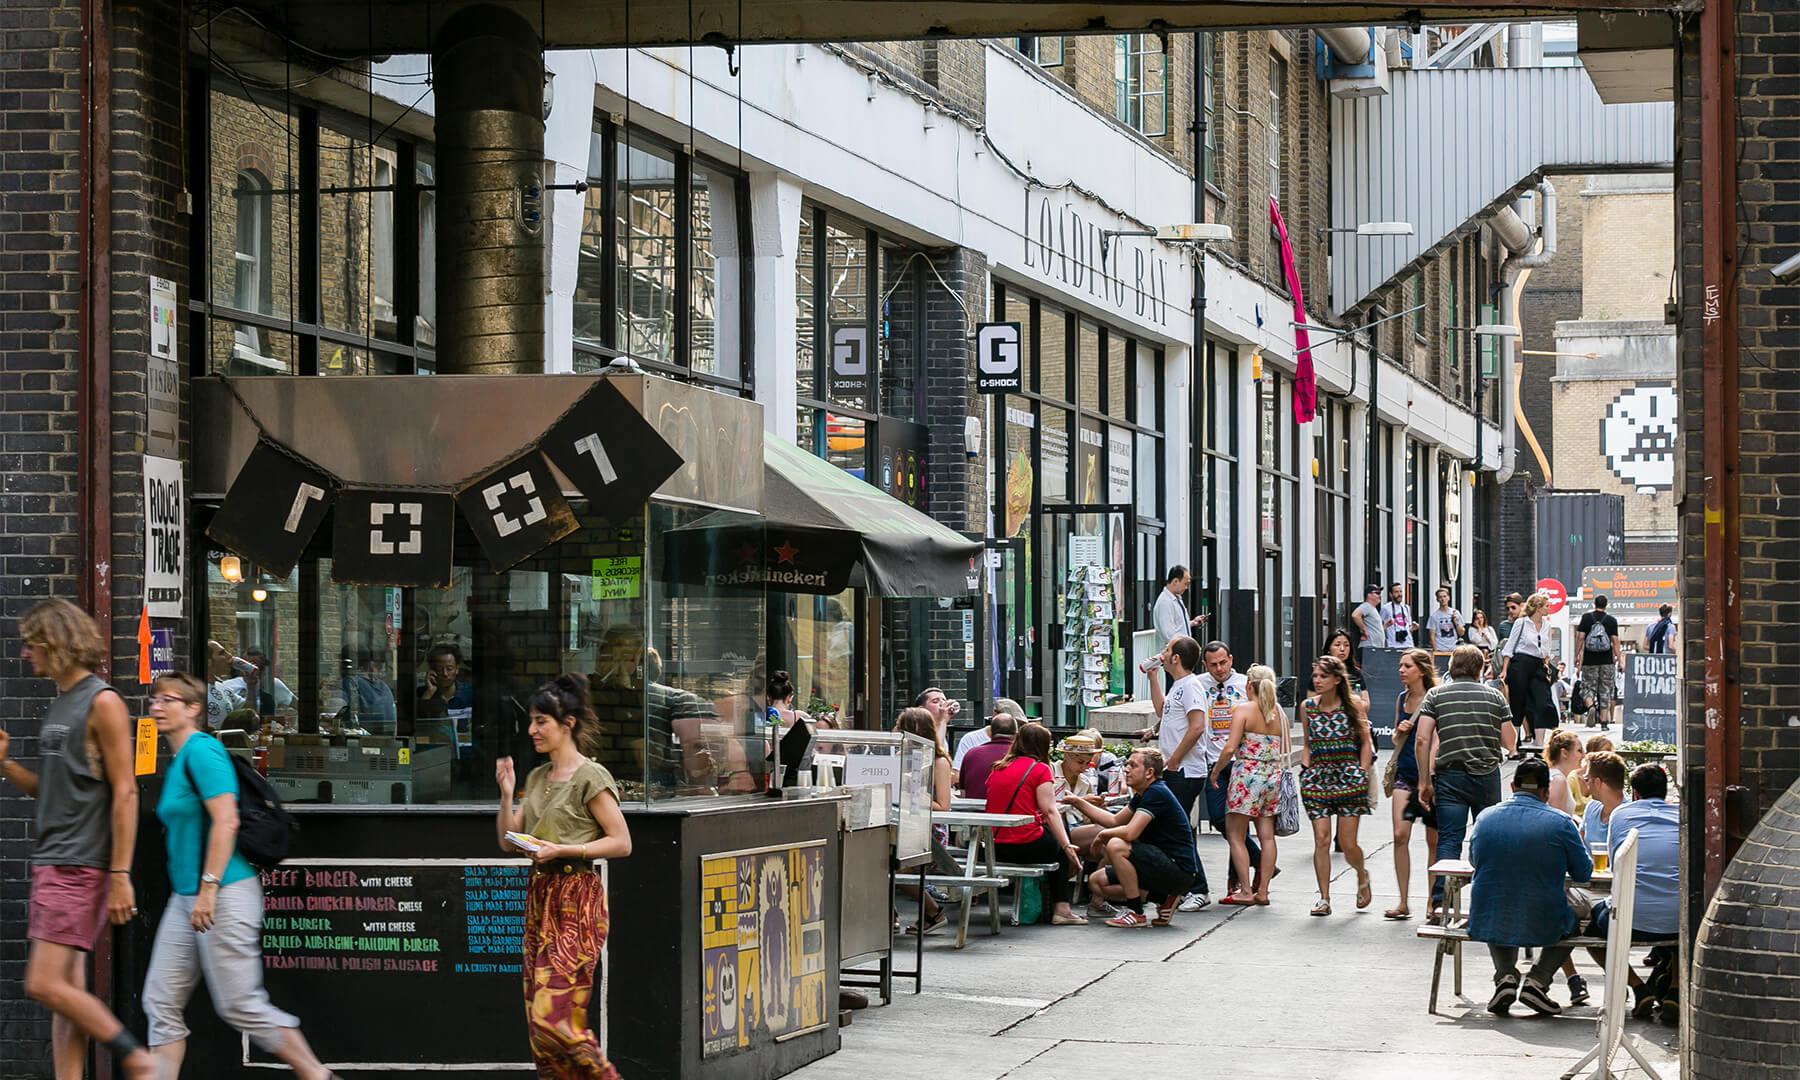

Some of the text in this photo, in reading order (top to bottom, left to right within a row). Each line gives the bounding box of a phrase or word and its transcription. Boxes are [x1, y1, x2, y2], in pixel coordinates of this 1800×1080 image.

[1023, 187, 1167, 326] LOADING BAY
[979, 325, 1018, 374] G
[979, 379, 1018, 387] G-SHOCK
[149, 478, 180, 526] ROUGH
[151, 528, 180, 576] TRADE
[1613, 581, 1657, 589] ORANGE
[1613, 589, 1658, 598] BUFFALO
[464, 867, 487, 876] SALAD
[262, 870, 413, 887] BEEF BURGER WITH CHEESE
[465, 890, 489, 900] SALAD
[263, 896, 423, 912] GRILLED CHICKEN BURGER CHEESE
[291, 918, 333, 931] BURGER
[363, 922, 386, 932] WITH
[388, 922, 416, 932] CHEESE
[467, 915, 490, 925] SALAD
[467, 926, 486, 934] HOME
[262, 935, 302, 949] GRILLED
[403, 938, 441, 952] BURGER
[468, 936, 491, 945] SALAD
[264, 955, 438, 972] TRADITIONAL POLISH SAUSAGE
[464, 964, 470, 972] A
[471, 964, 497, 972] CRUSTY
